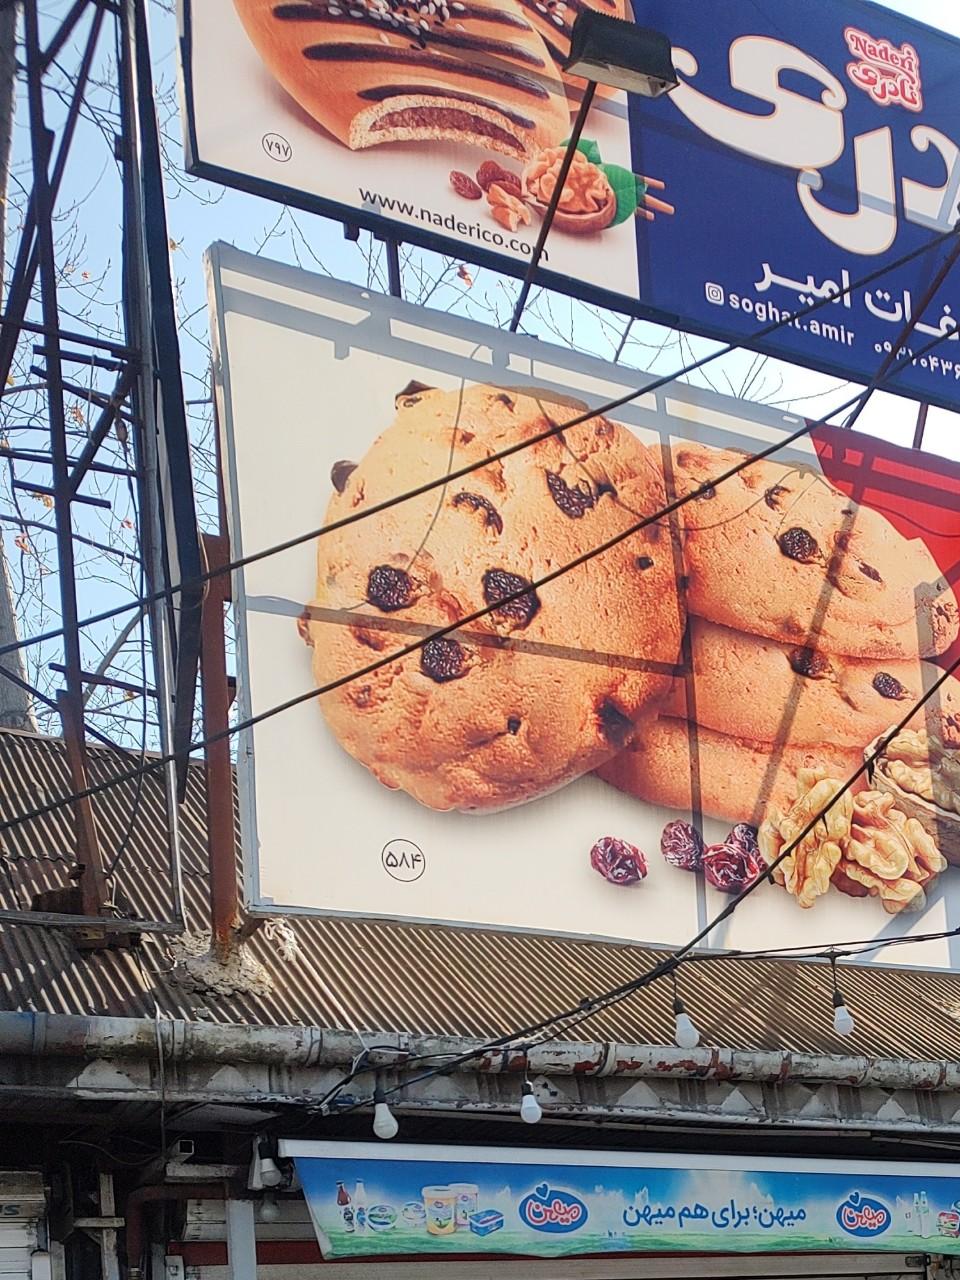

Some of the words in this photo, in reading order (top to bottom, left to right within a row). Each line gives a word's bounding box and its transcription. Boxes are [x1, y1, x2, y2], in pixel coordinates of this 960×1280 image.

[850, 31, 916, 73] Naderi
[849, 63, 919, 106] نادری
[265, 137, 289, 157] ۷۹۷
[358, 187, 550, 262] www.naderico.com
[754, 261, 851, 308] امیر
[729, 291, 855, 347] soghat.amir
[385, 851, 422, 869] ۵۸۴
[526, 1198, 584, 1225] میهن
[622, 1204, 676, 1229] میهن
[678, 1206, 709, 1229] هم
[711, 1198, 750, 1229] برای
[841, 1206, 889, 1229] میهن
